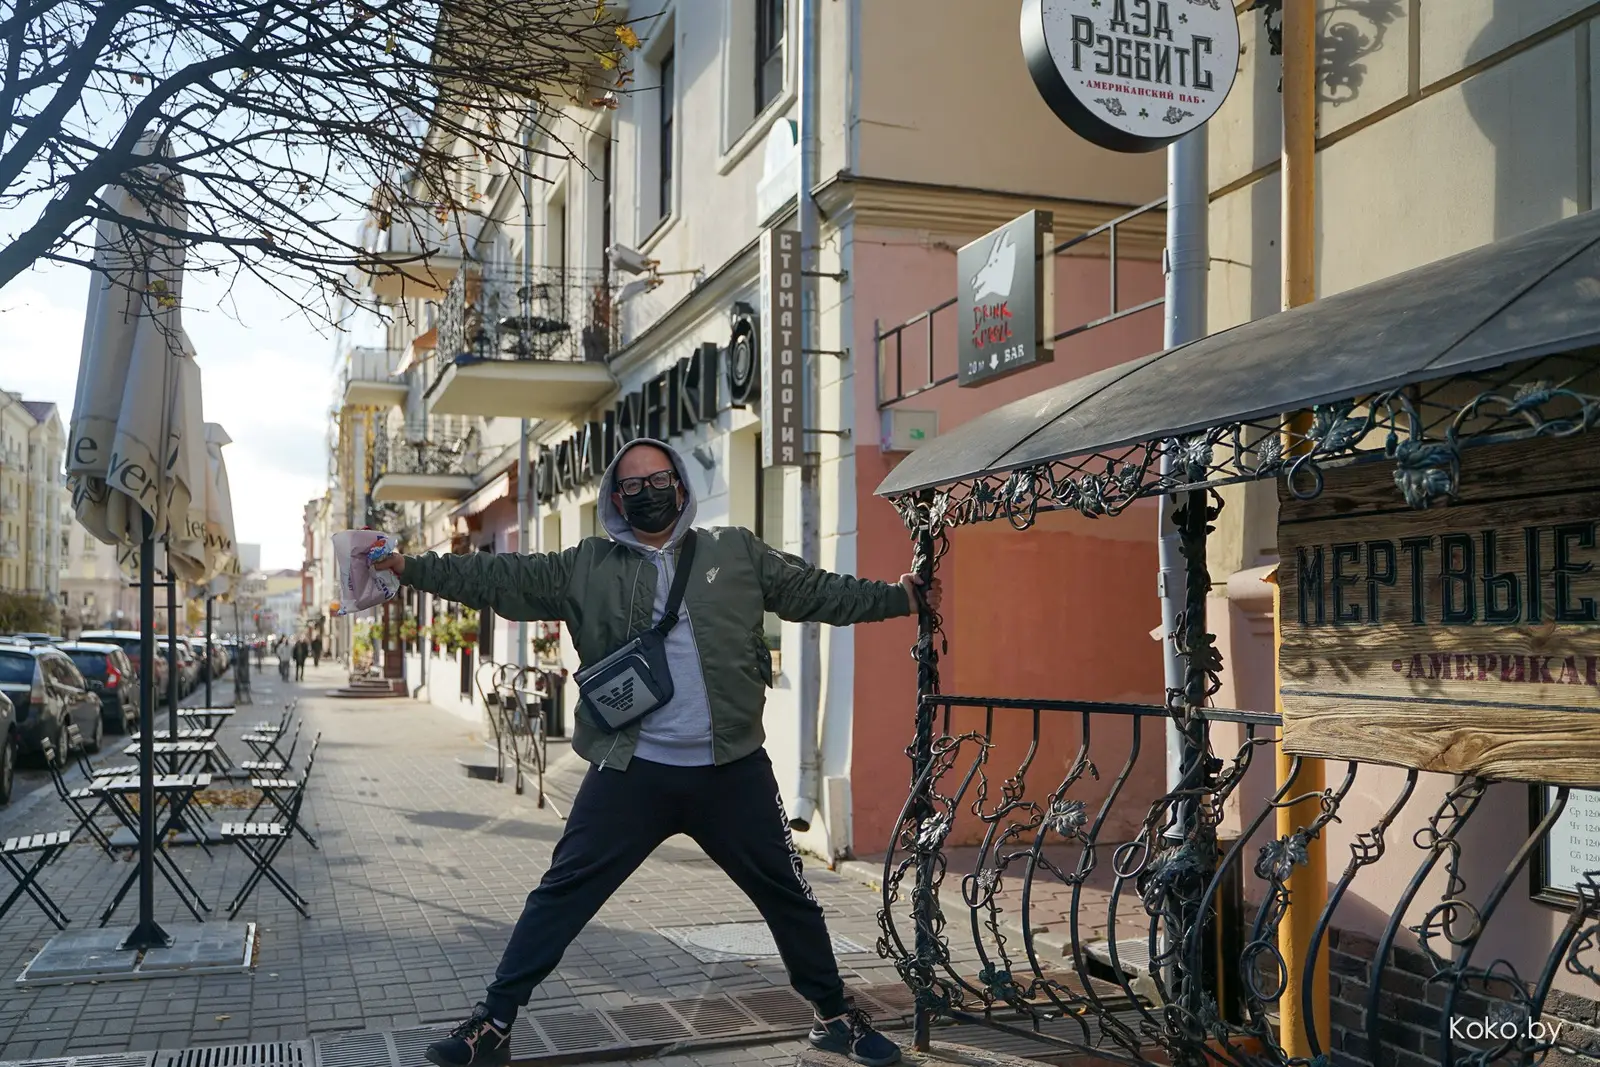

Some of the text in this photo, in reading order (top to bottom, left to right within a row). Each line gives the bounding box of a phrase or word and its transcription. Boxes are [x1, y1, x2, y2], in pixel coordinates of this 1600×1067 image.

[1109, 0, 1173, 42] ДЭД
[1071, 14, 1214, 92] РЭББИТС
[1086, 79, 1200, 104] АМЕРИКАНСКИЙ ПАБ
[780, 234, 793, 462] СТОМАТОЛОГИЯ
[1004, 344, 1024, 363] BAR
[1296, 521, 1600, 627] МЕРТВЫЕ
